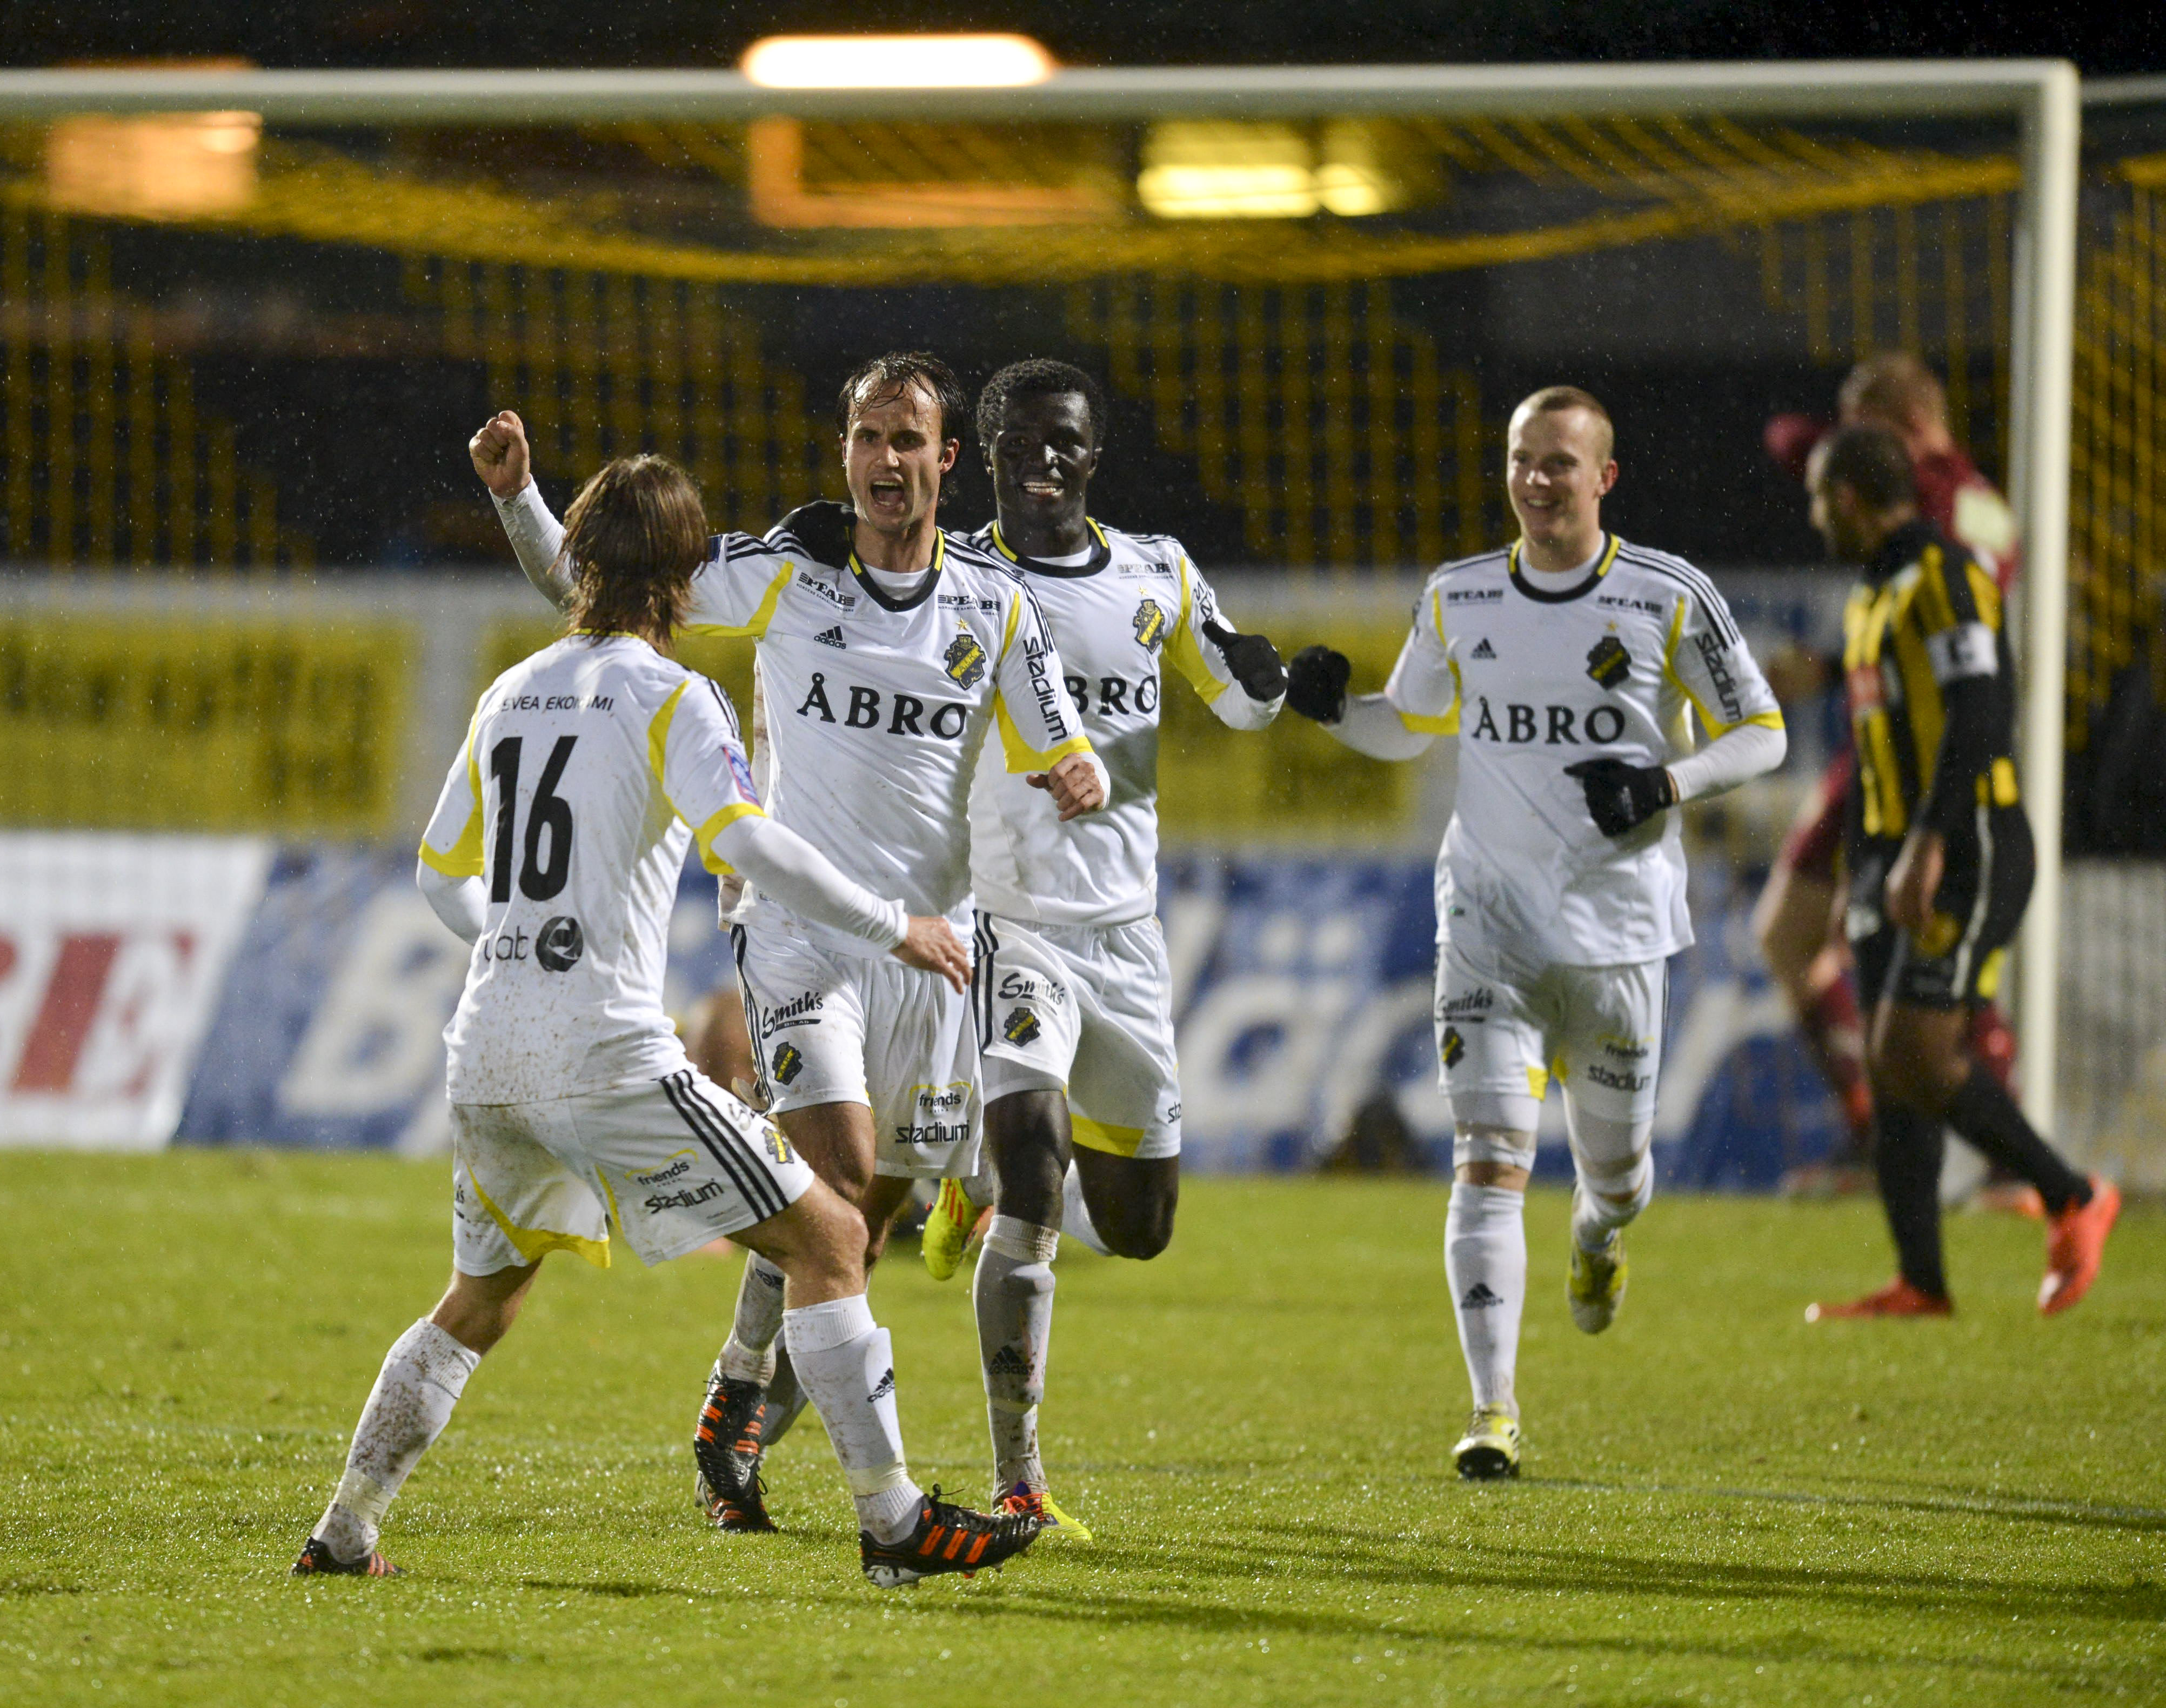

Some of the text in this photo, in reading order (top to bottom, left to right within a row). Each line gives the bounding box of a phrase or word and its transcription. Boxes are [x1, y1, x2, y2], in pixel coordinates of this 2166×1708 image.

[806, 575, 847, 605] PEAB
[813, 635, 847, 650] adidas
[546, 695, 614, 711] EKOMI
[796, 672, 967, 740] ÅBRO
[1023, 636, 1068, 742] stadium
[1062, 676, 1158, 716] BRO
[1471, 695, 1626, 744] ÅBRO
[491, 735, 579, 903] 16
[761, 991, 824, 1039] Smith's
[919, 1092, 961, 1107] friends
[895, 1121, 970, 1144] stadium
[637, 1162, 690, 1186] friends
[645, 1178, 725, 1215] stadium
